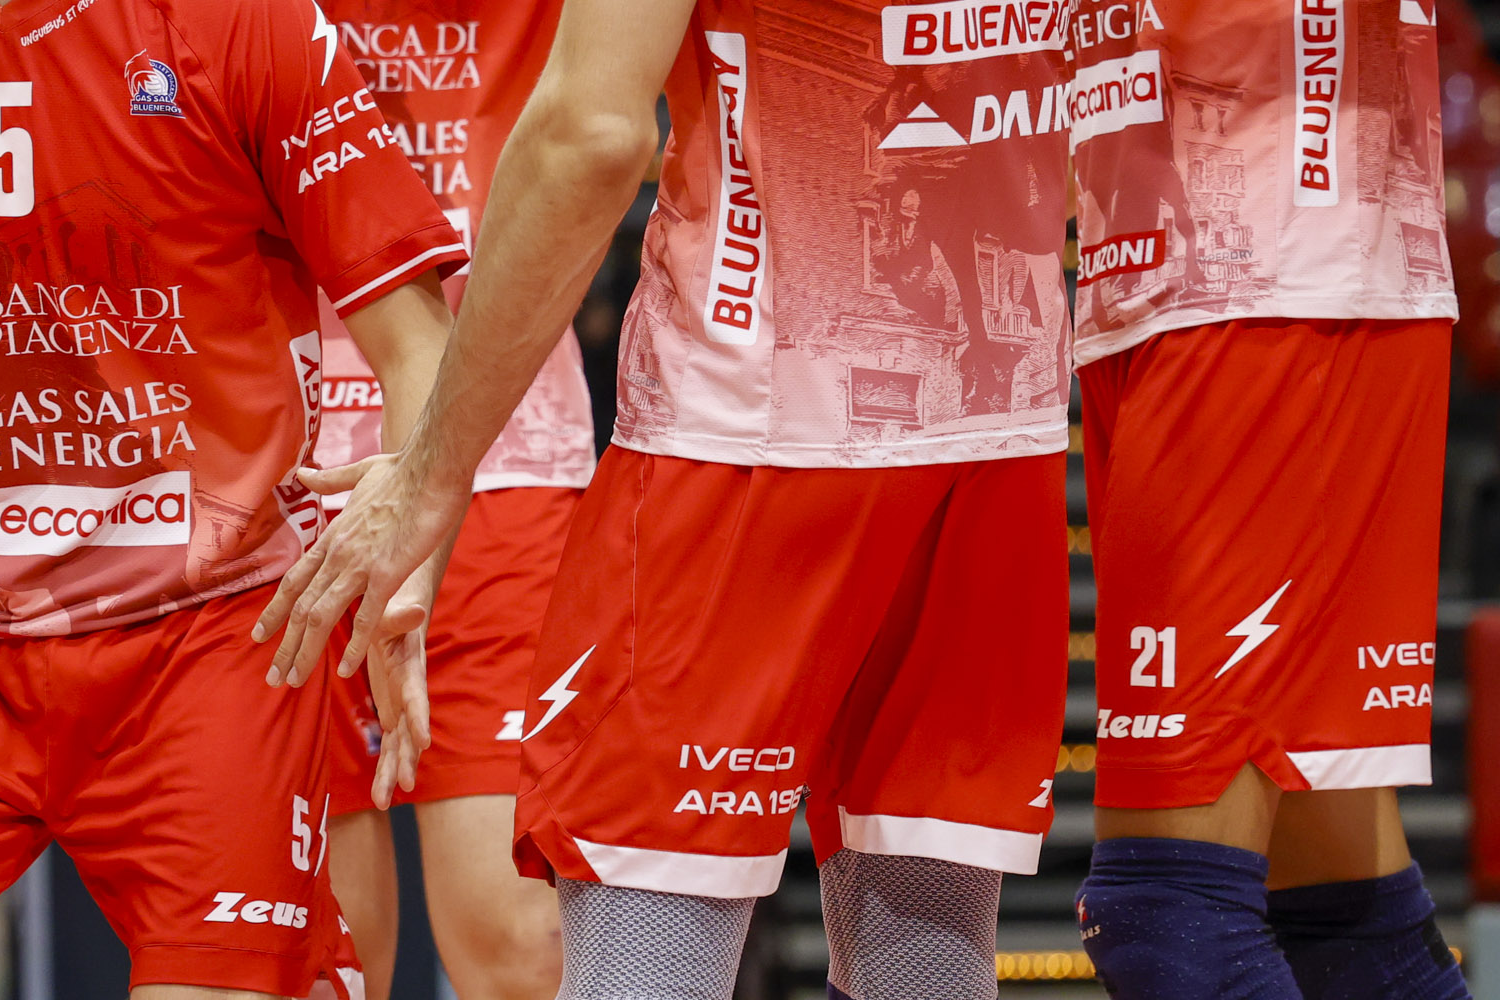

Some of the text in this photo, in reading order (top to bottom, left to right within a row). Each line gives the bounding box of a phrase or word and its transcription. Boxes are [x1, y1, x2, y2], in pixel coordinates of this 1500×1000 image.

[65, 4, 78, 23] ET
[436, 21, 480, 56] DI
[298, 141, 367, 195] ARA
[130, 285, 186, 320] DI
[74, 381, 192, 425] SALES
[1130, 625, 1177, 688] 21
[1362, 682, 1433, 711] ARA
[678, 743, 796, 772] IVECO
[672, 788, 765, 816] ARA
[291, 793, 312, 872] 5
[203, 892, 309, 930] Zeus
